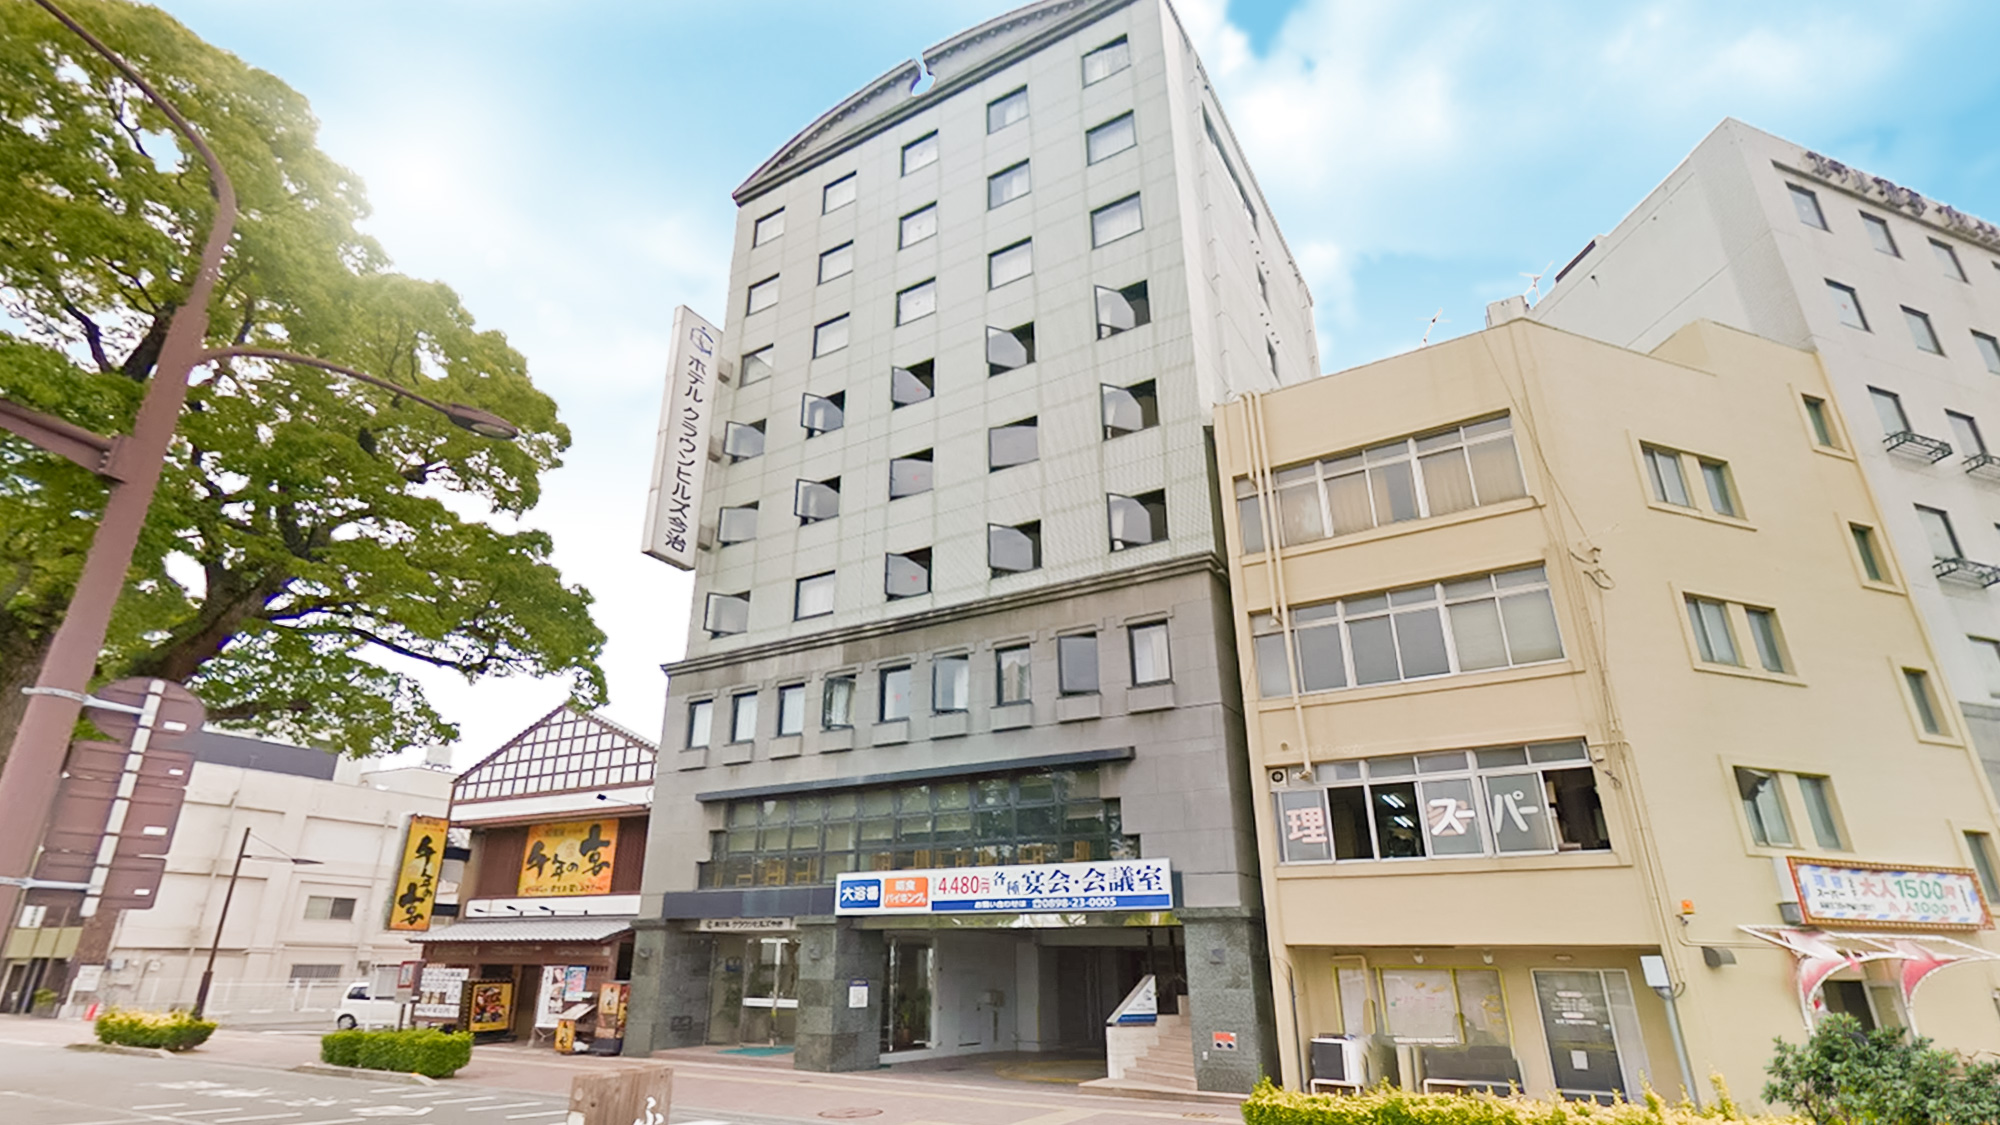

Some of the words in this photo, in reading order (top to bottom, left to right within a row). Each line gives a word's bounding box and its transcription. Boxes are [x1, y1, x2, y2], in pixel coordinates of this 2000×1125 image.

[684, 355, 707, 403] ホテル
[1428, 790, 1539, 836] スーパー
